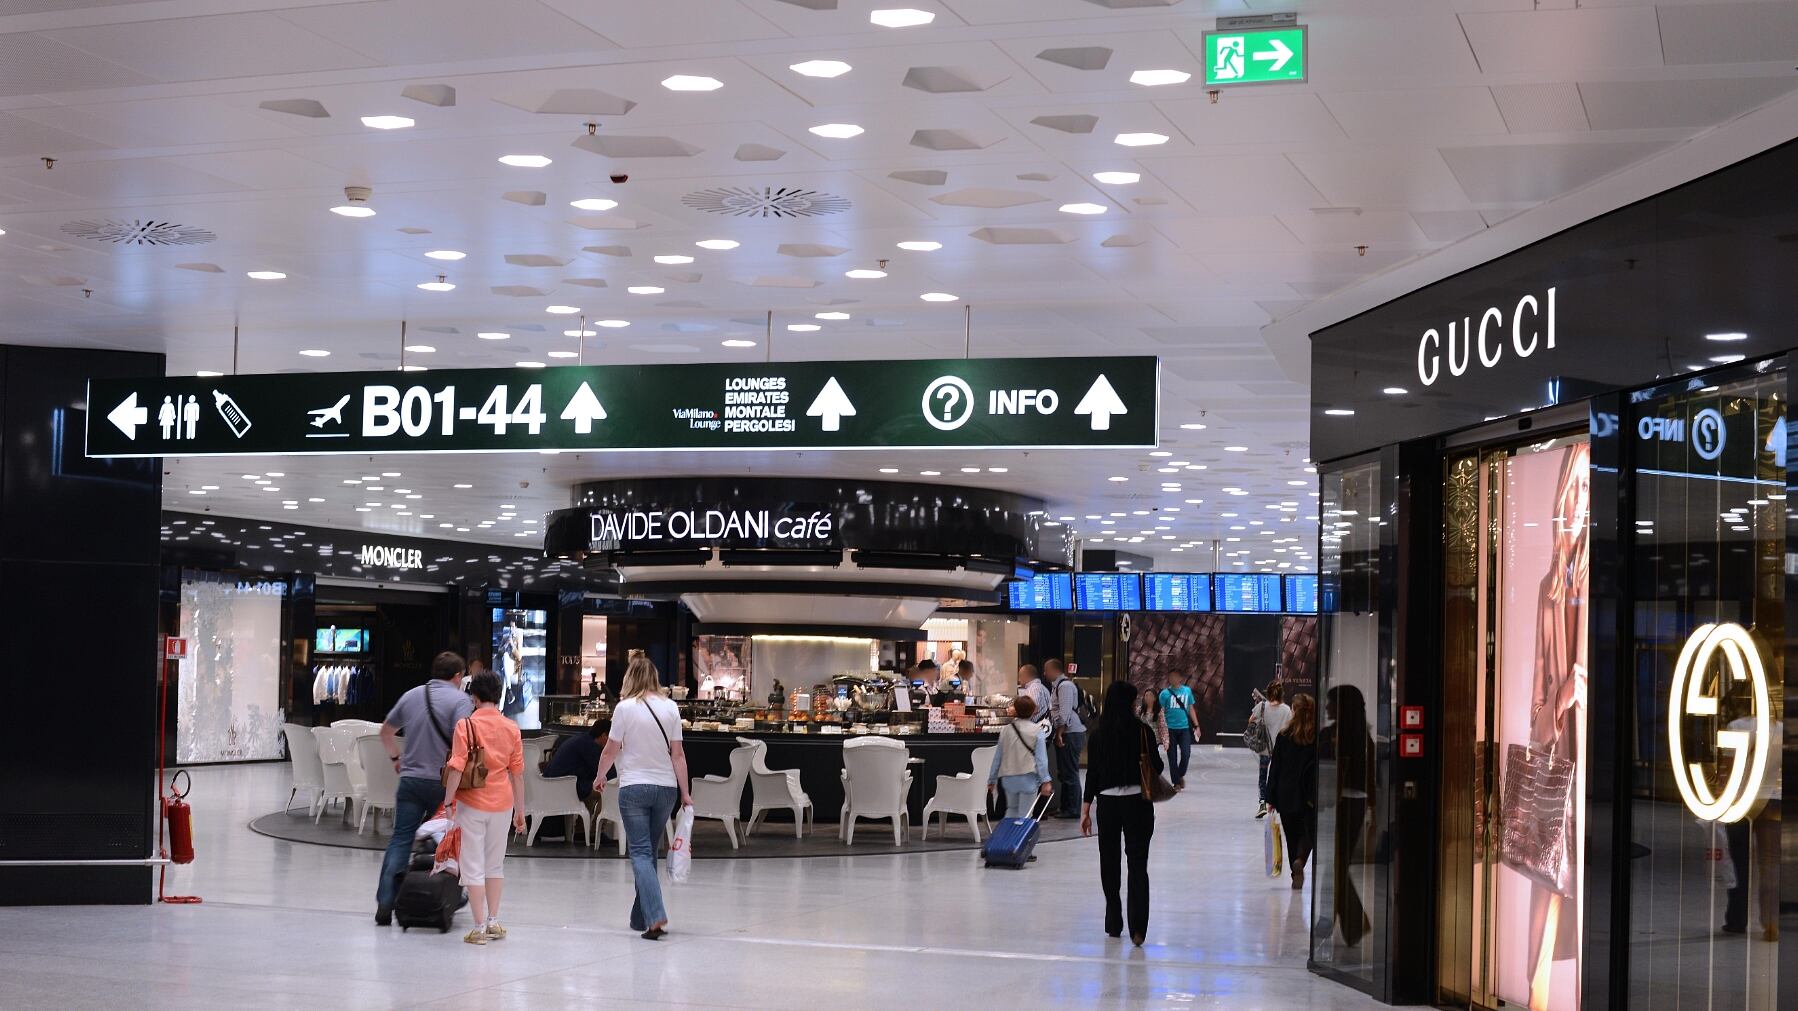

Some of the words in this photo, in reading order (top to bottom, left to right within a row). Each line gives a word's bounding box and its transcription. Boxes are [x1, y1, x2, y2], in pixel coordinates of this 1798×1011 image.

[1417, 287, 1558, 386] GUCCI
[725, 377, 787, 391] LOUNGES
[725, 391, 790, 404] EMIRATES
[988, 388, 1058, 415] INFO
[362, 383, 547, 437] B01-44
[672, 408, 714, 419] ViaMilano
[724, 405, 785, 419] MONTALE
[690, 419, 721, 431] Lounge
[724, 419, 796, 433] PERGOLESI
[590, 512, 663, 541] DAVIDE
[668, 510, 769, 539] OLDANI
[774, 511, 832, 539] café
[361, 544, 423, 569] MONCLER
